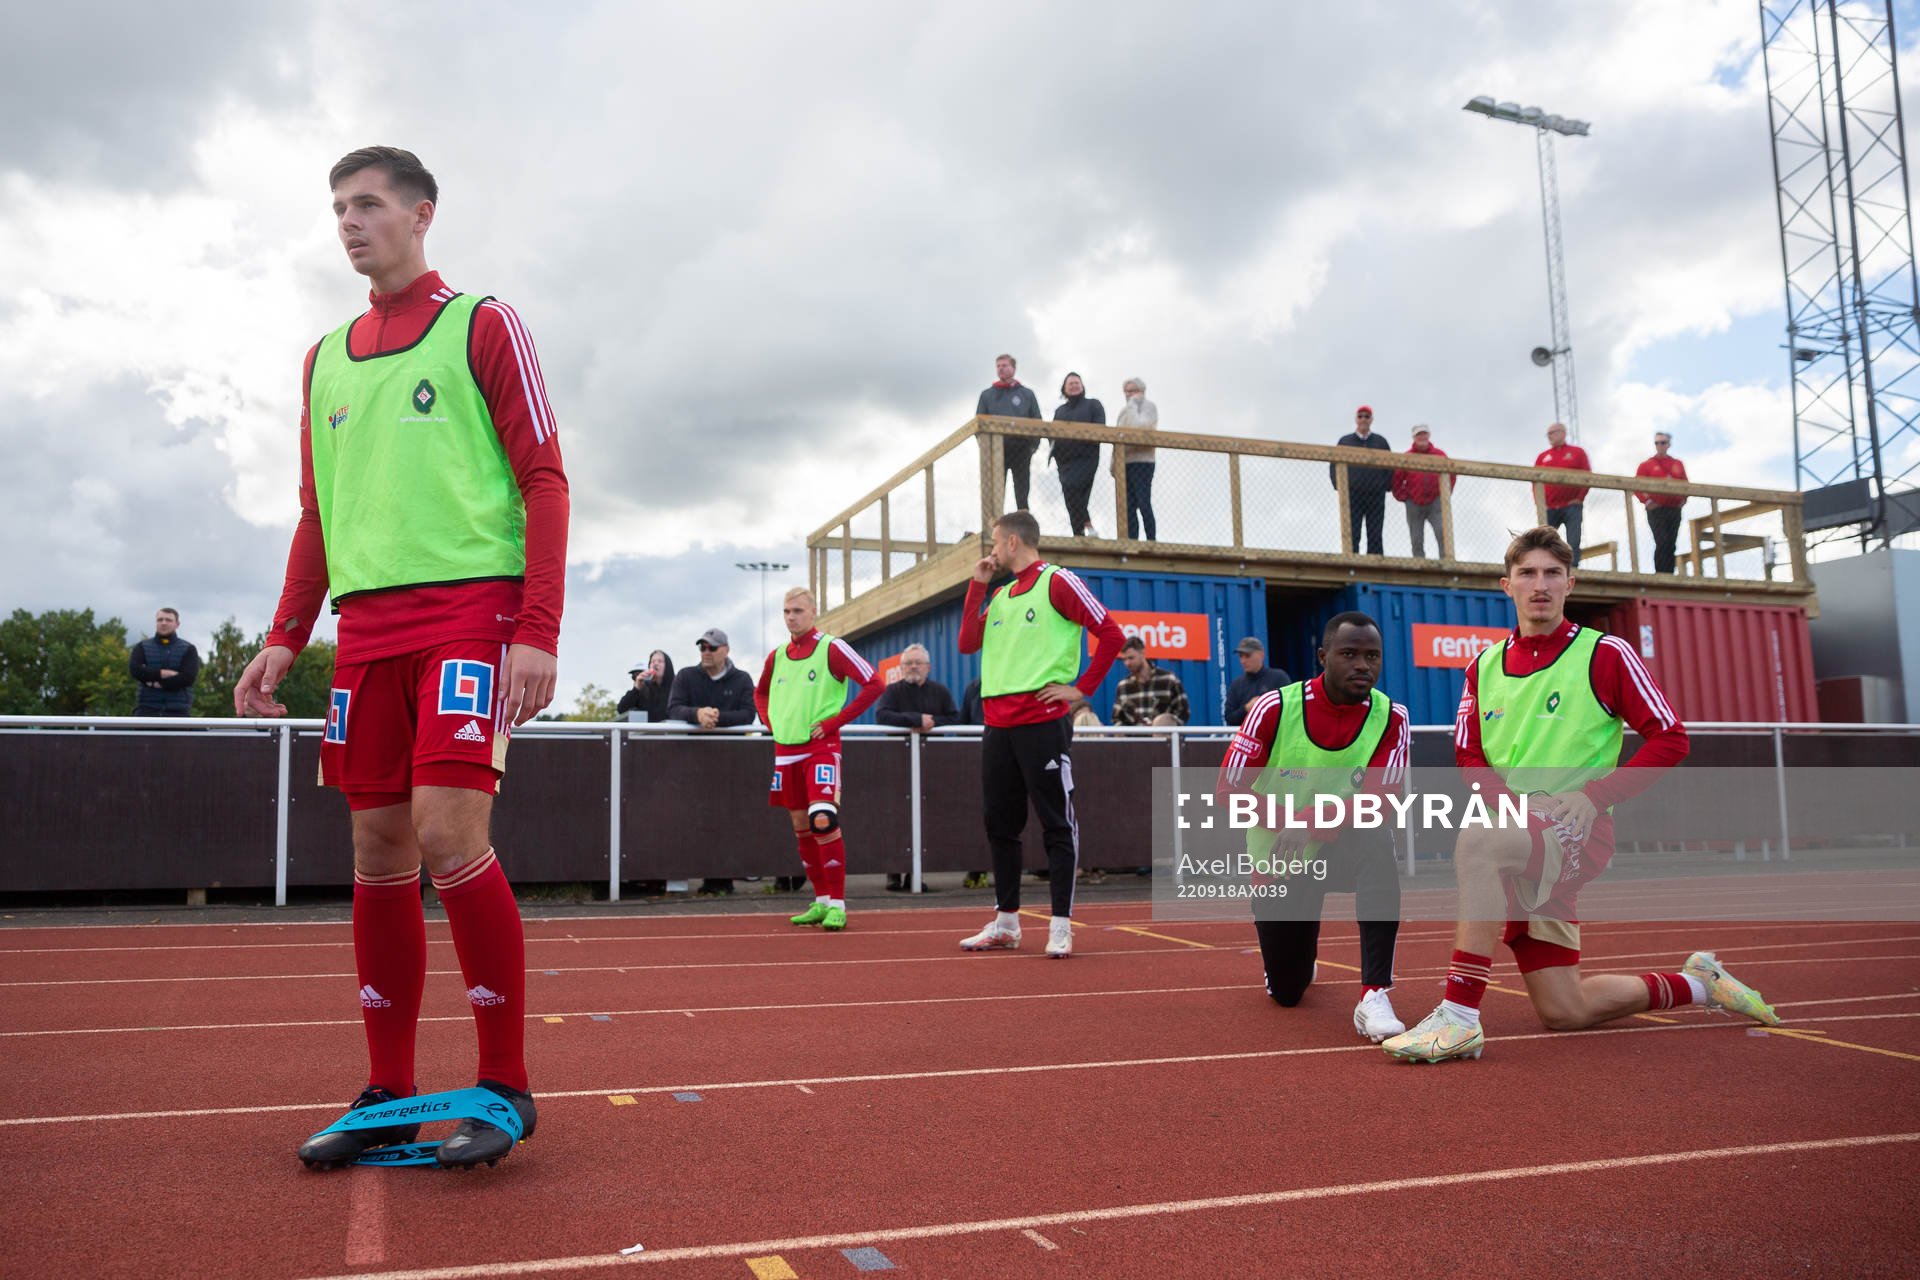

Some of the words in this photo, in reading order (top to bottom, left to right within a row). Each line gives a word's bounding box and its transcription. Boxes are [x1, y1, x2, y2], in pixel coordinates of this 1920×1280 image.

[1118, 620, 1187, 649] enta
[454, 732, 485, 742] adidas
[363, 1101, 451, 1120] energetics
